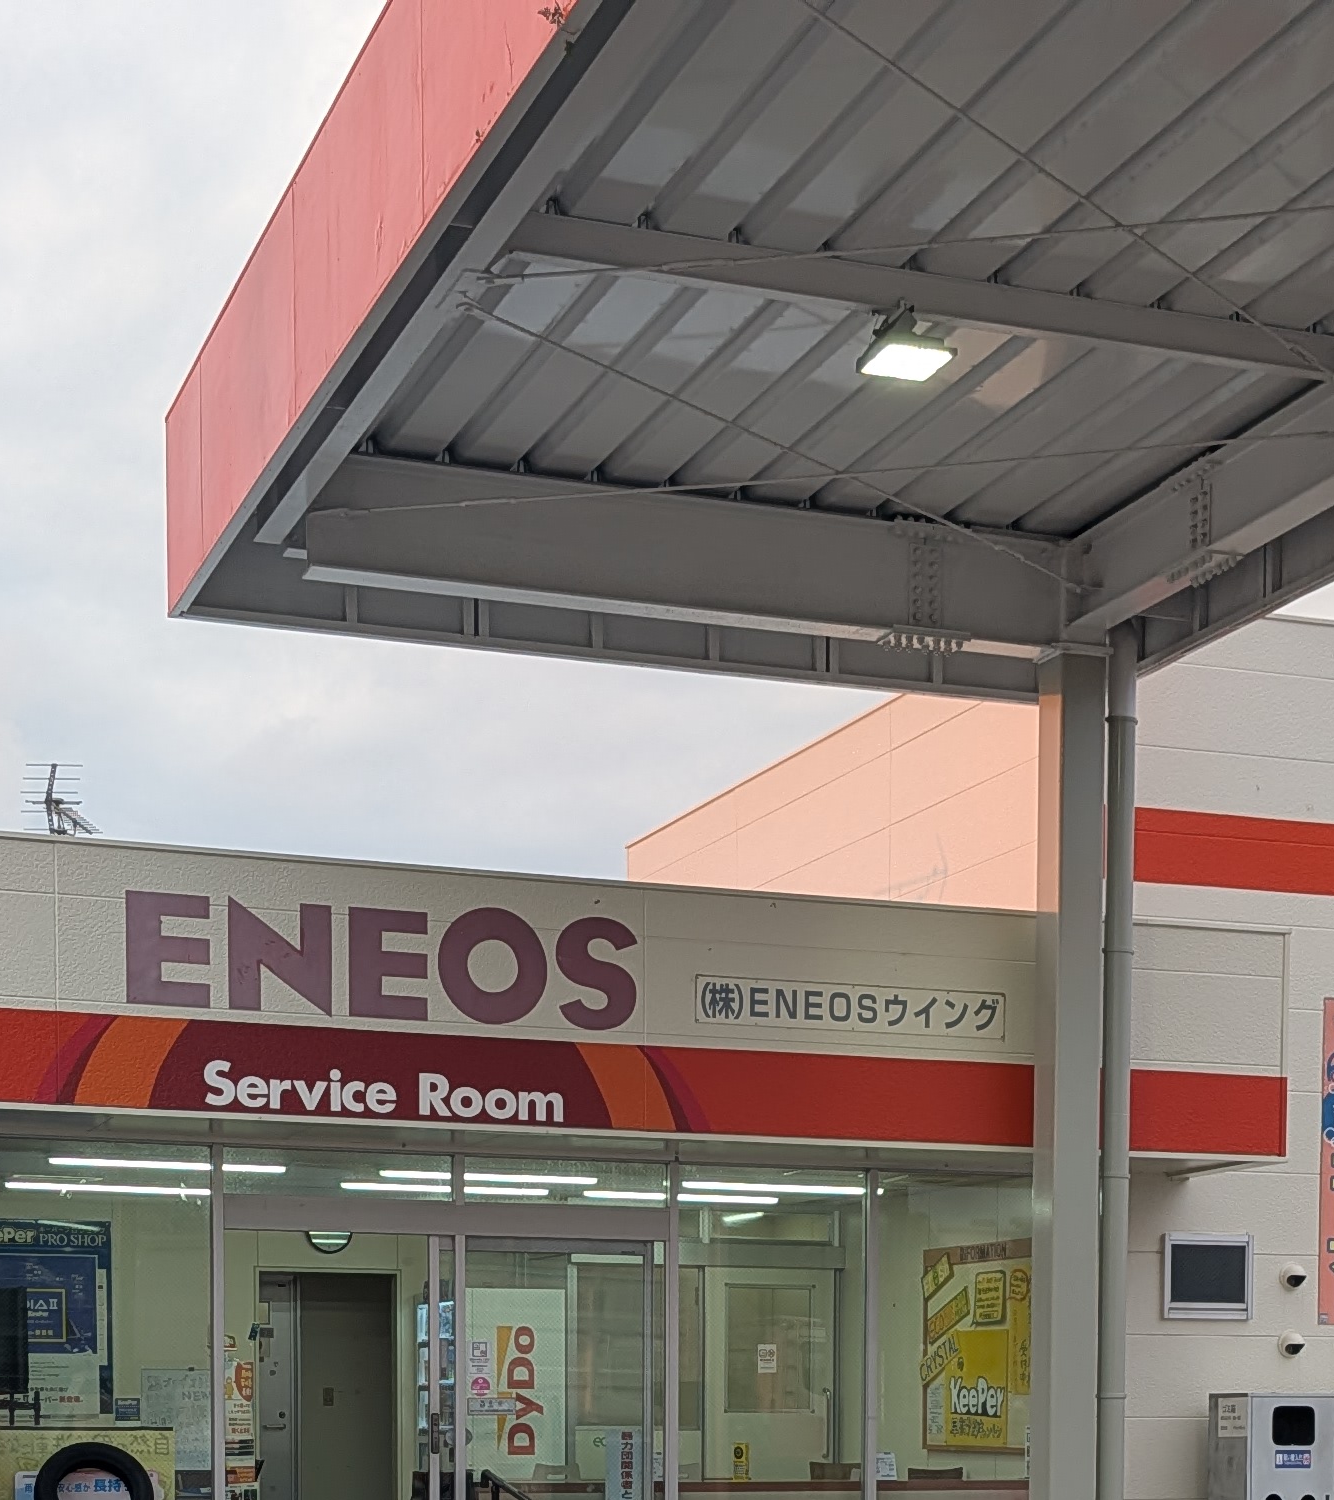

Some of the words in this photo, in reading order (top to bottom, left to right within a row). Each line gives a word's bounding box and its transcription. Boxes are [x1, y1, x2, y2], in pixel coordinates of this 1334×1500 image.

[125, 889, 638, 1032] ENEOS
[203, 1060, 396, 1114] Service
[418, 1073, 565, 1123] Room
[39, 1233, 68, 1246] PRO
[69, 1234, 107, 1247] SHOP
[919, 1333, 959, 1383] CRYSTAL
[507, 1325, 545, 1456] DyDo
[949, 1375, 1005, 1417] KeePer
